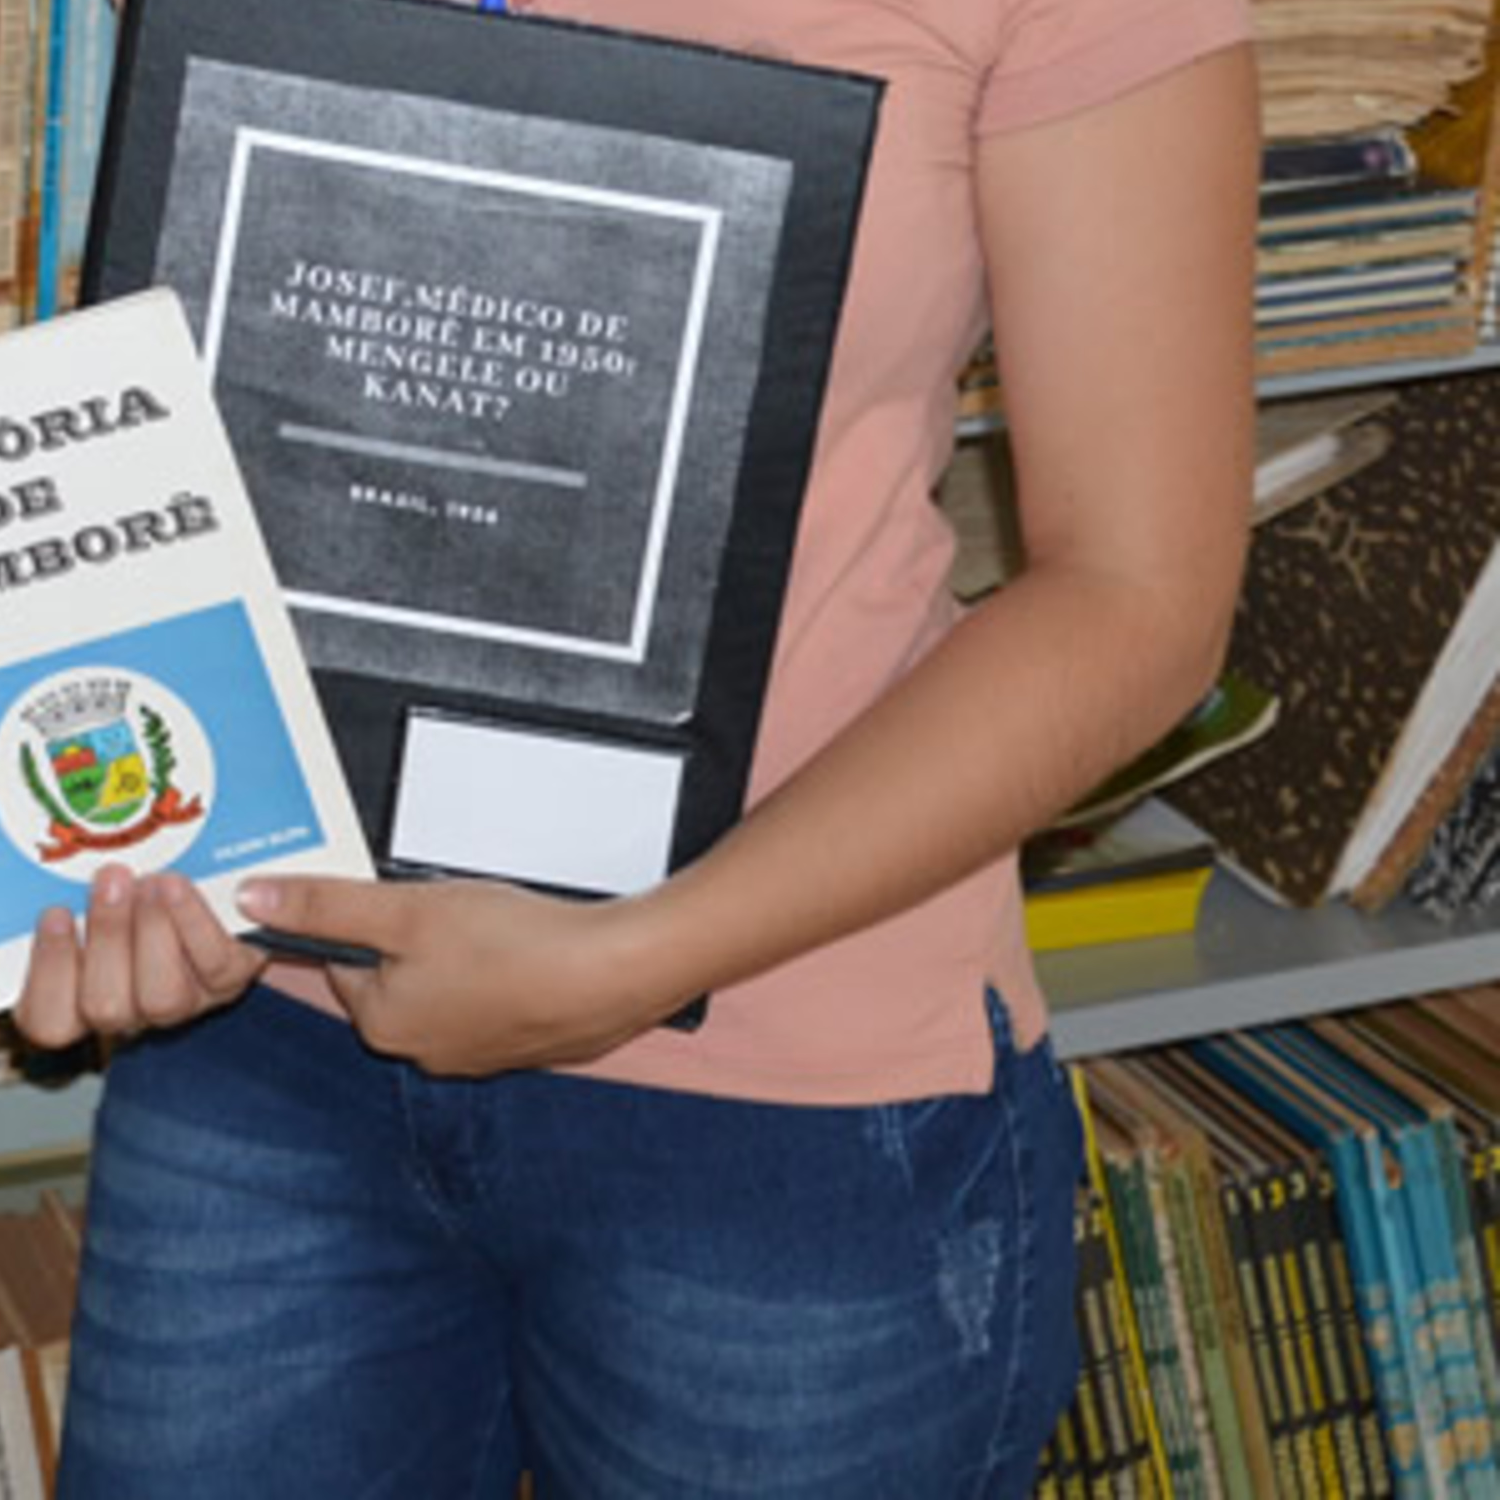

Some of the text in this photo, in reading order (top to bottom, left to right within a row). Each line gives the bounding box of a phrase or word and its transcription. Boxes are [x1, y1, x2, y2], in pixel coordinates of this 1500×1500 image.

[471, 326, 528, 359] EM
[577, 310, 629, 343] DE
[327, 334, 571, 398] MENGELE OU
[363, 372, 512, 422] KANAT?
